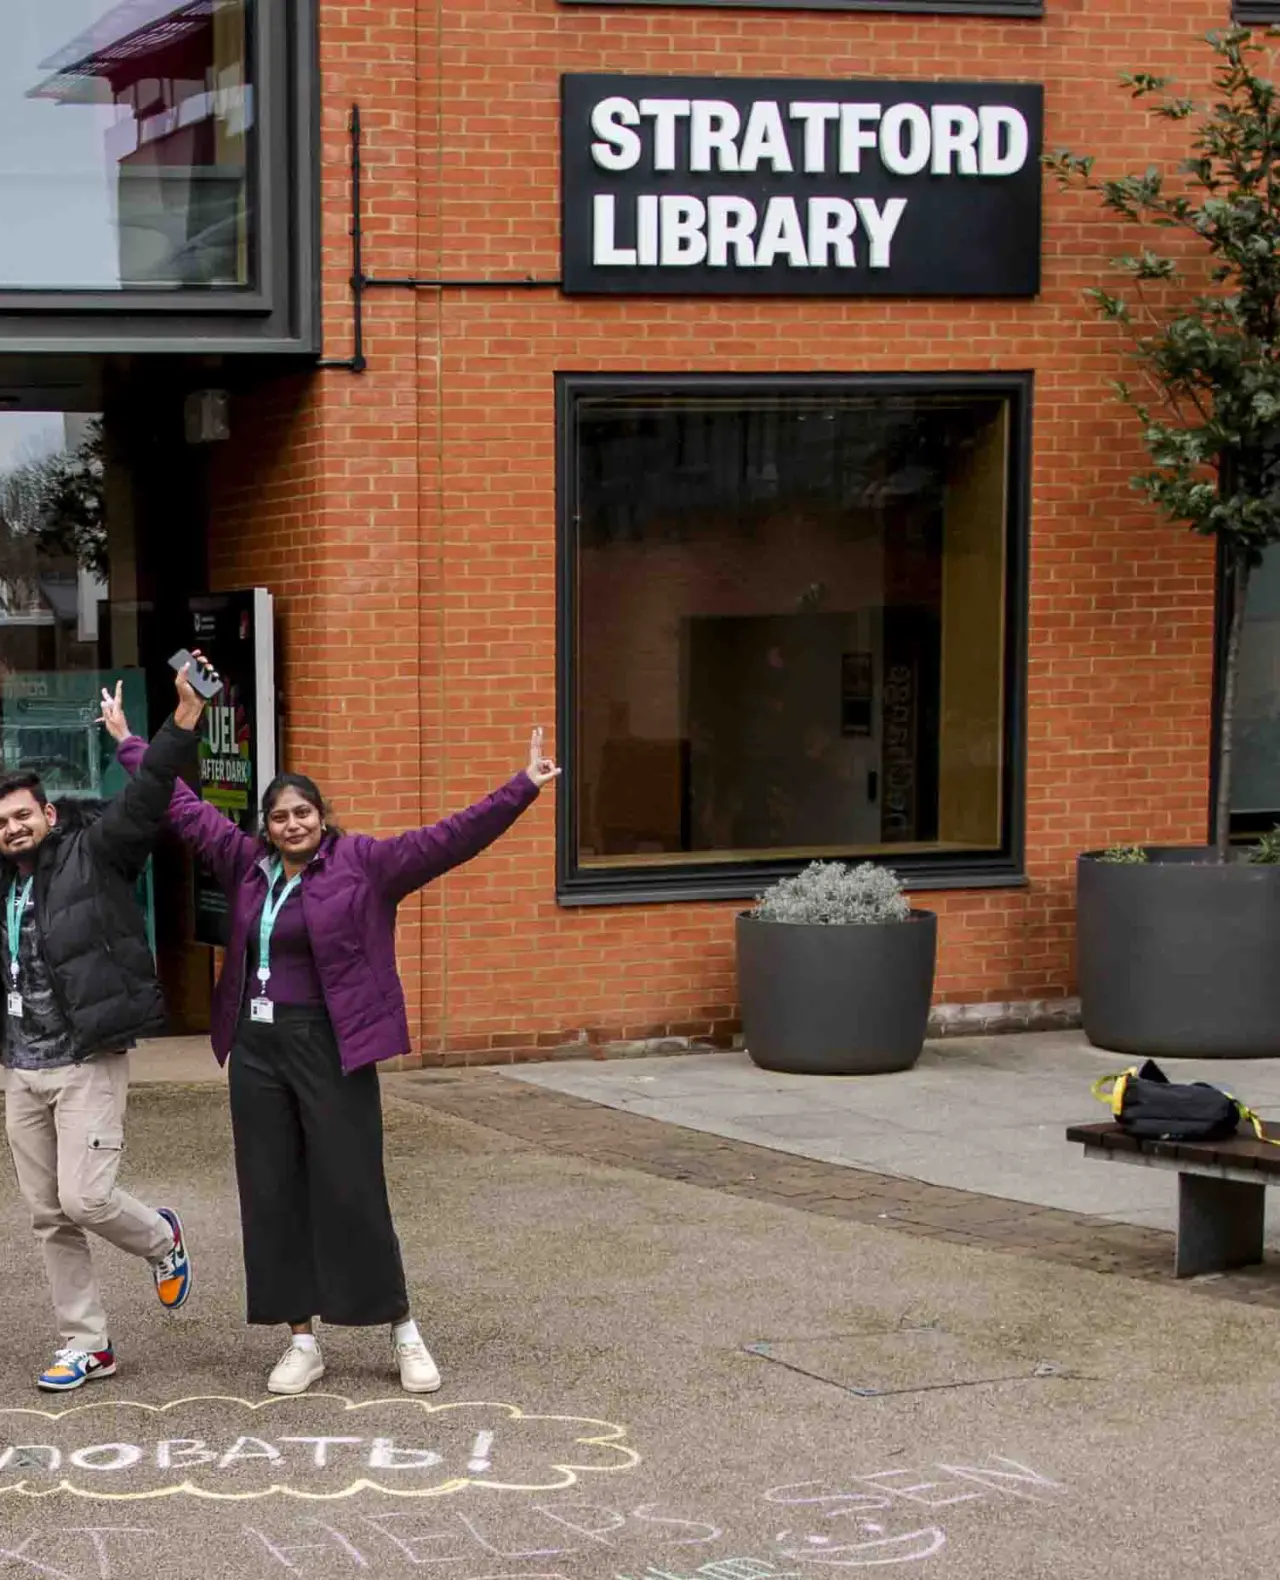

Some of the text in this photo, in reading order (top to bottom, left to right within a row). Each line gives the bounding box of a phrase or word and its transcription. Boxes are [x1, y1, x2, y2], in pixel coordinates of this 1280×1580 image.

[590, 97, 1029, 175] STRATFORD
[593, 194, 908, 268] LIBRARY
[208, 706, 240, 754] UEL
[201, 759, 249, 783] AFTER DARK
